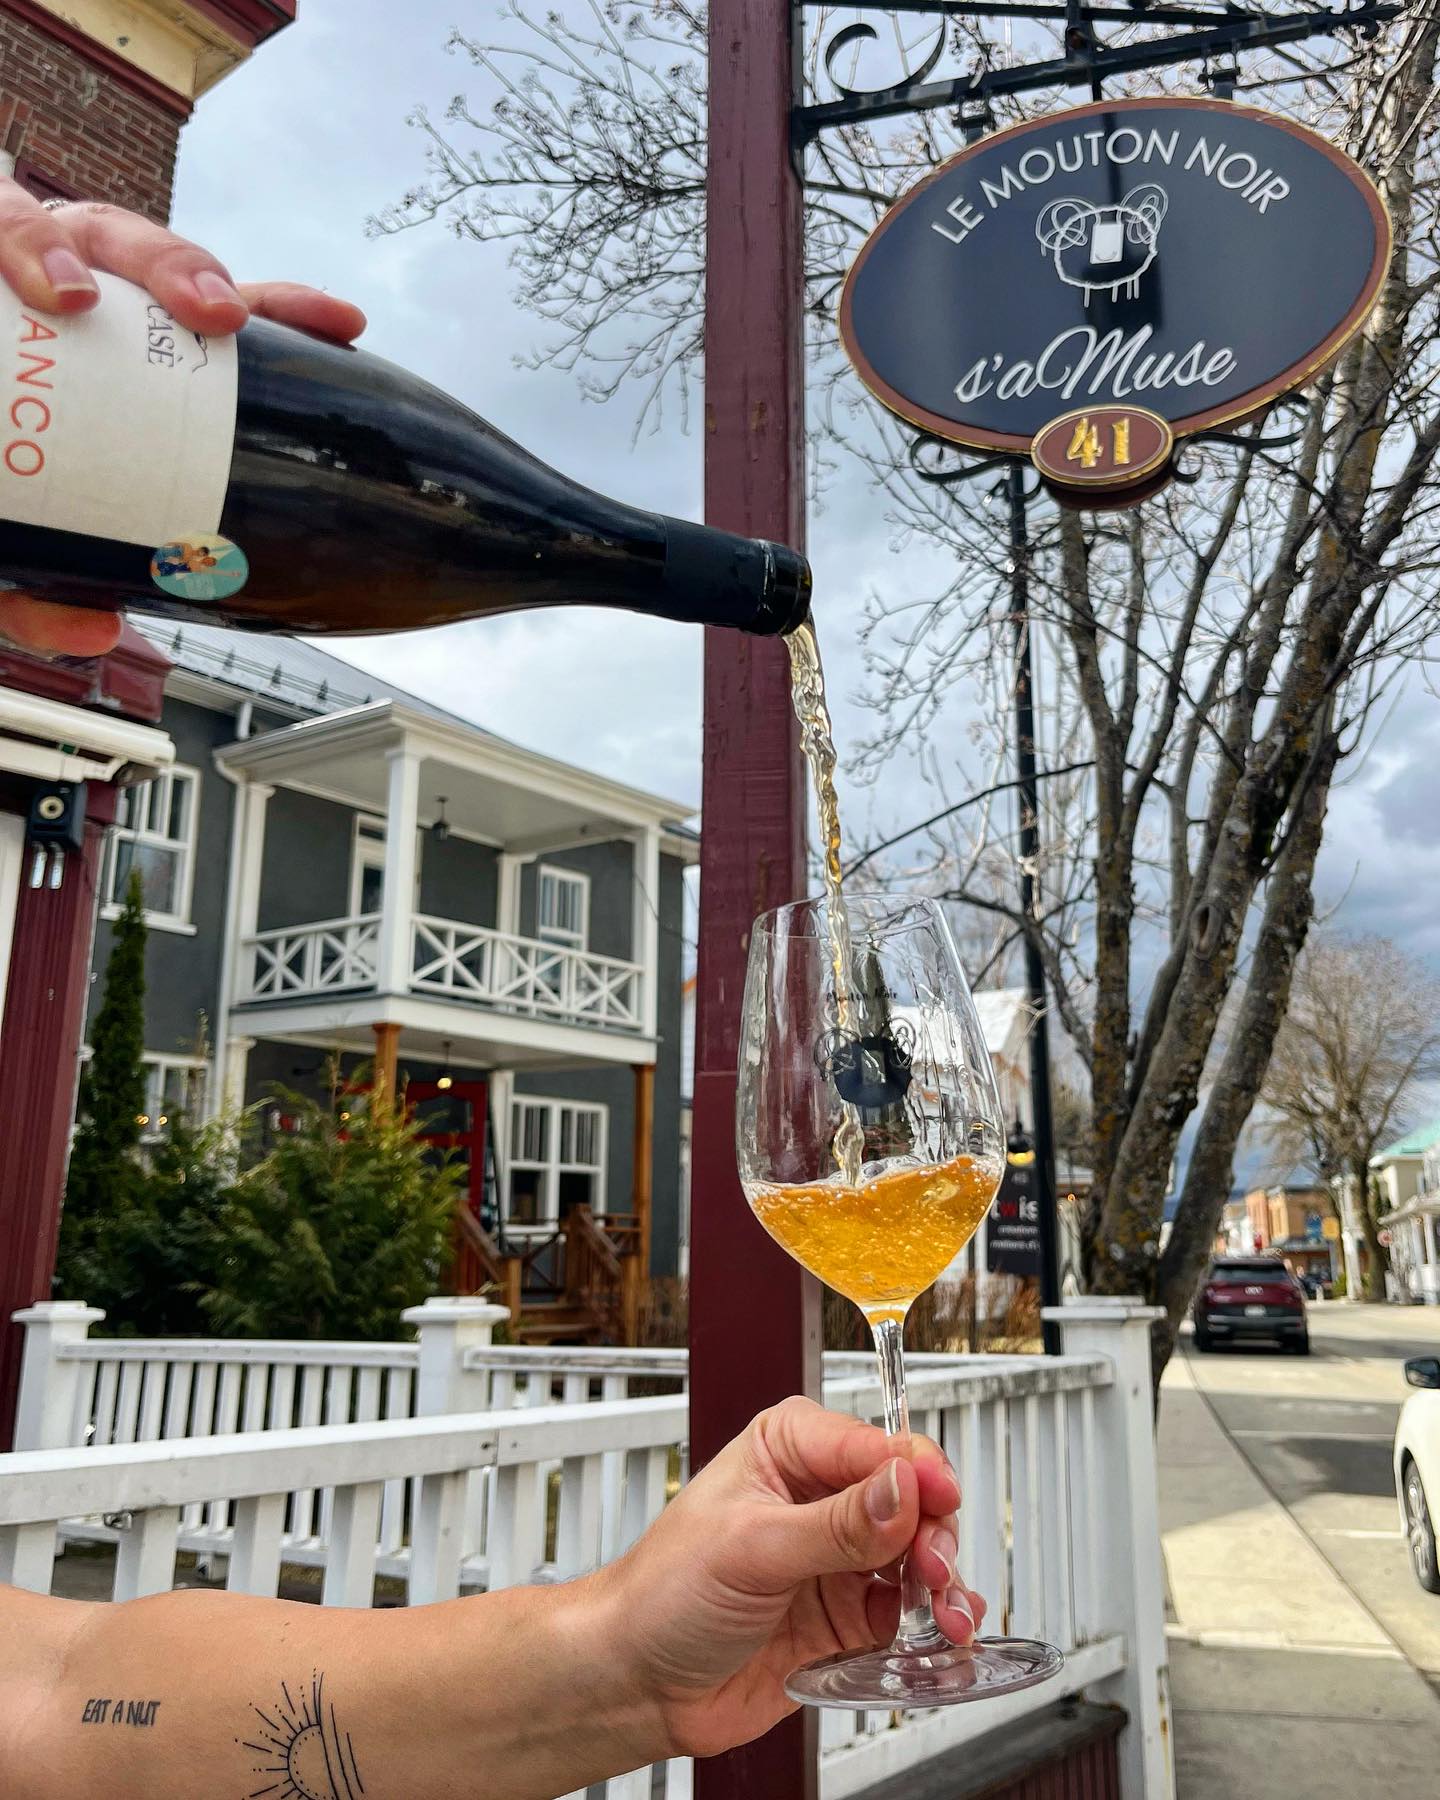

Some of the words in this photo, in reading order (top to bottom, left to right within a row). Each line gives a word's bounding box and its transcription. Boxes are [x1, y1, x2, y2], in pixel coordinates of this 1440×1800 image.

[931, 194, 985, 245] LE
[979, 127, 1181, 208] MOUTON
[1184, 136, 1291, 215] NOIR
[4, 314, 58, 477] ANCO
[1066, 416, 1131, 469] 41
[989, 1195, 1040, 1220] twis
[82, 1699, 112, 1723] EAT
[112, 1699, 124, 1725] A
[126, 1700, 161, 1727] NUT
